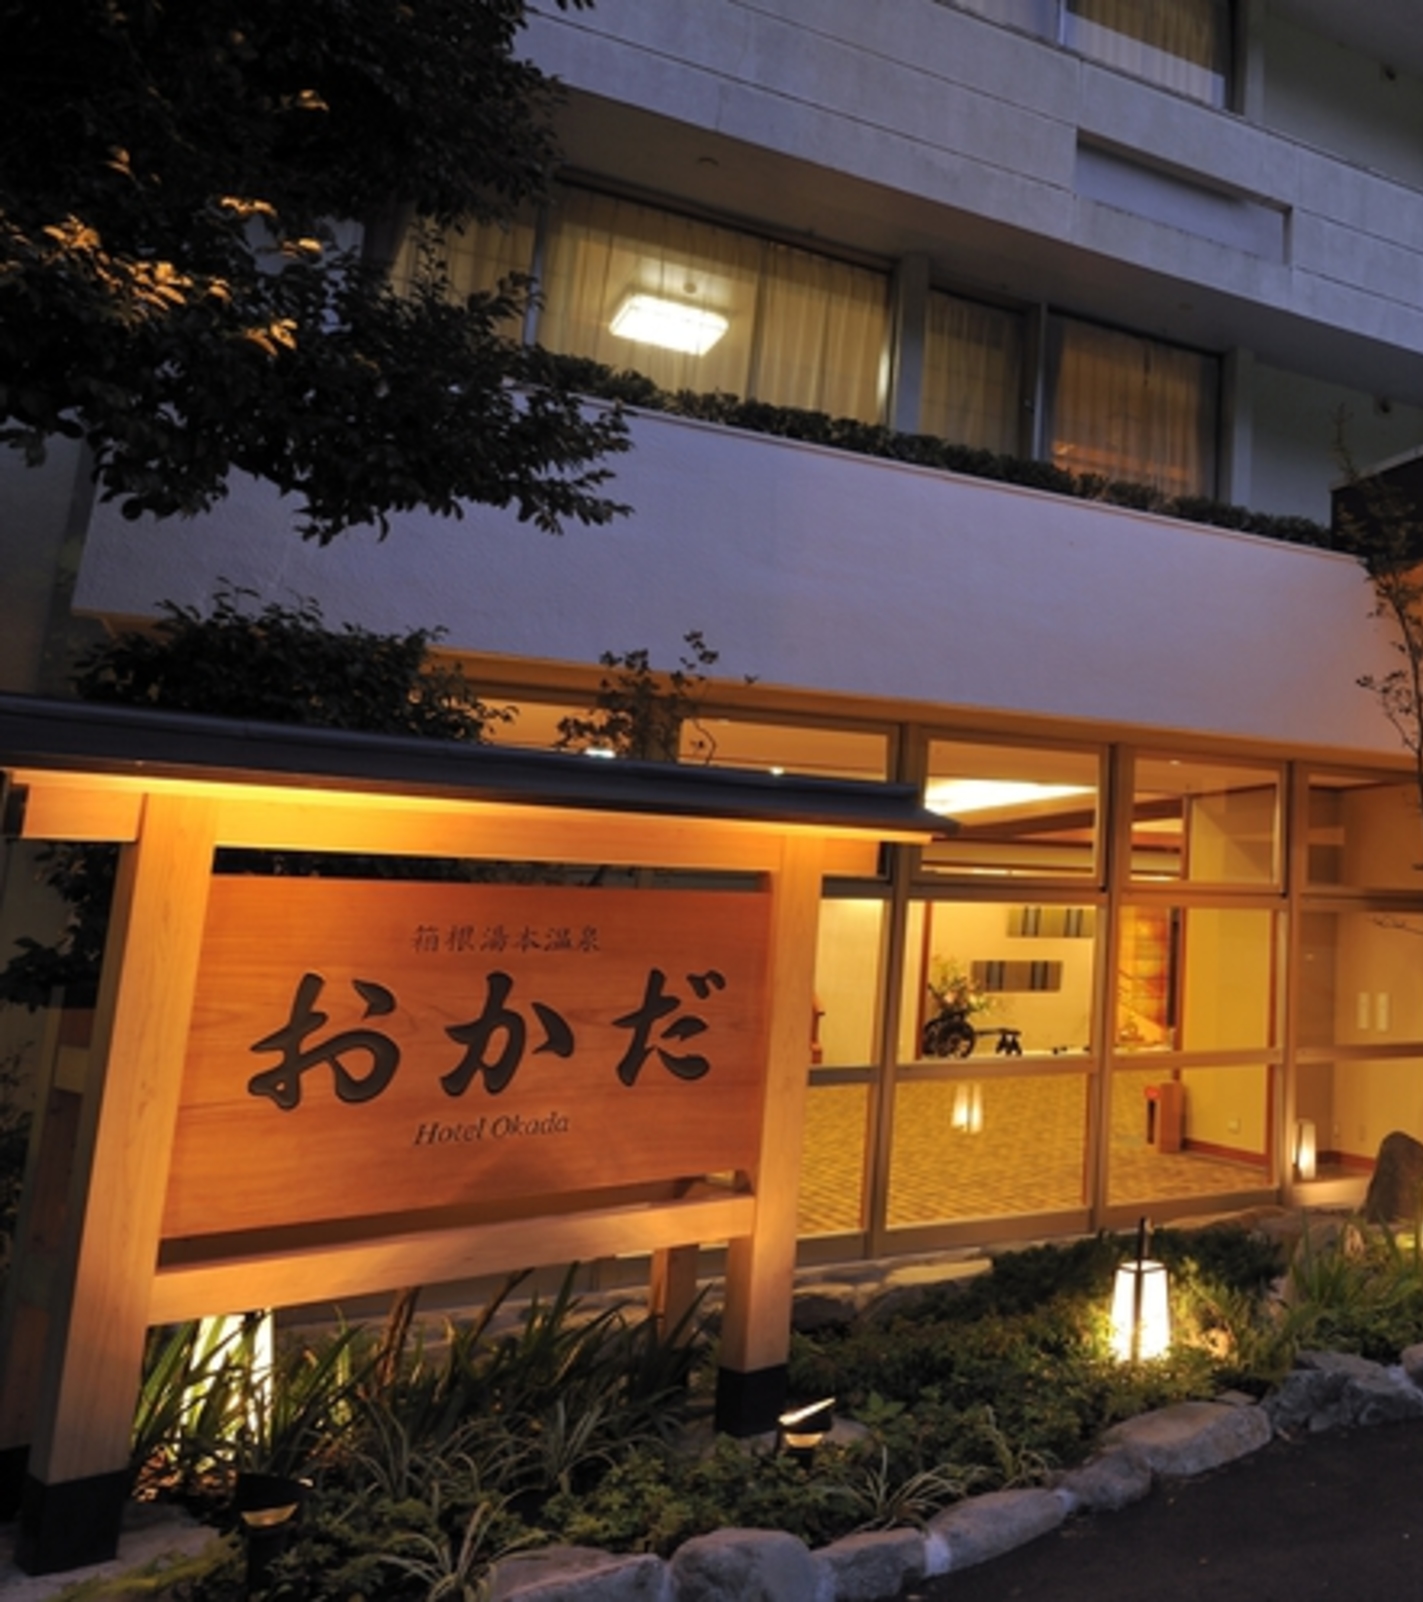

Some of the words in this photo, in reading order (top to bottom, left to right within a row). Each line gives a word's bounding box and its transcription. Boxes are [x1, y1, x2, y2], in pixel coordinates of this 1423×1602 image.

[411, 924, 600, 953] 箱根湯本温泉
[247, 967, 726, 1111] おかだ
[413, 1116, 486, 1146] Hotel
[492, 1111, 570, 1139] Okada
